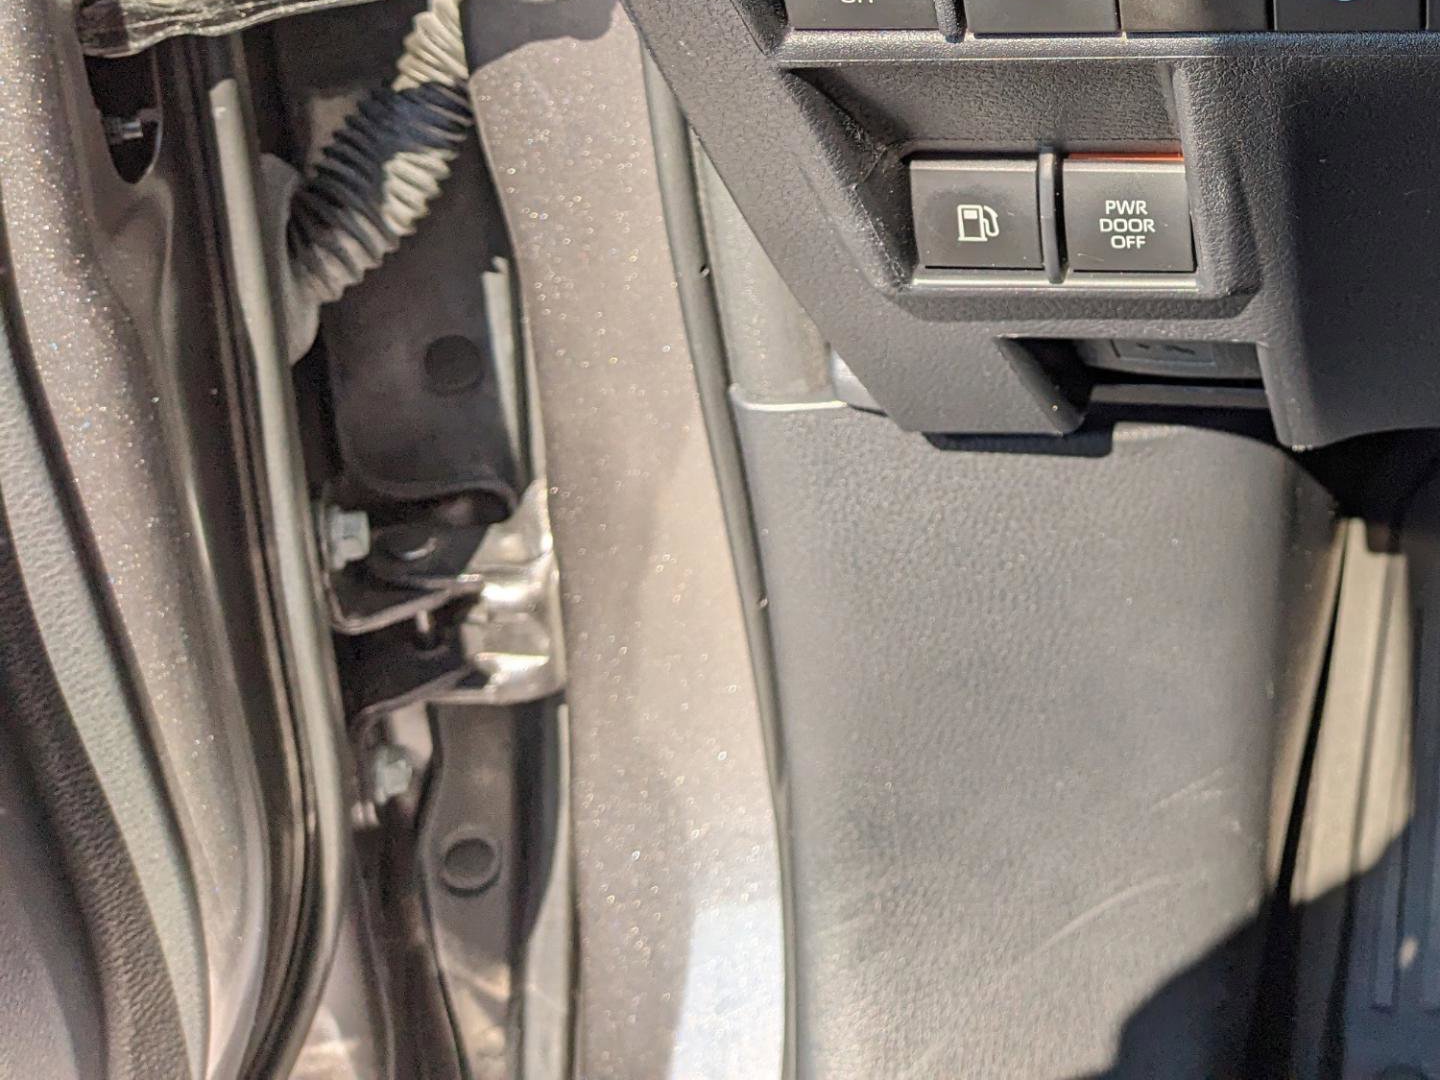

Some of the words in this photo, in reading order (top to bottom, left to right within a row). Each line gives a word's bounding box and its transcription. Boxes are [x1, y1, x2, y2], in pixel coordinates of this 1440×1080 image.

[1105, 200, 1148, 215] PWR
[1100, 218, 1156, 233] DOOR
[1110, 235, 1146, 249] OFF
